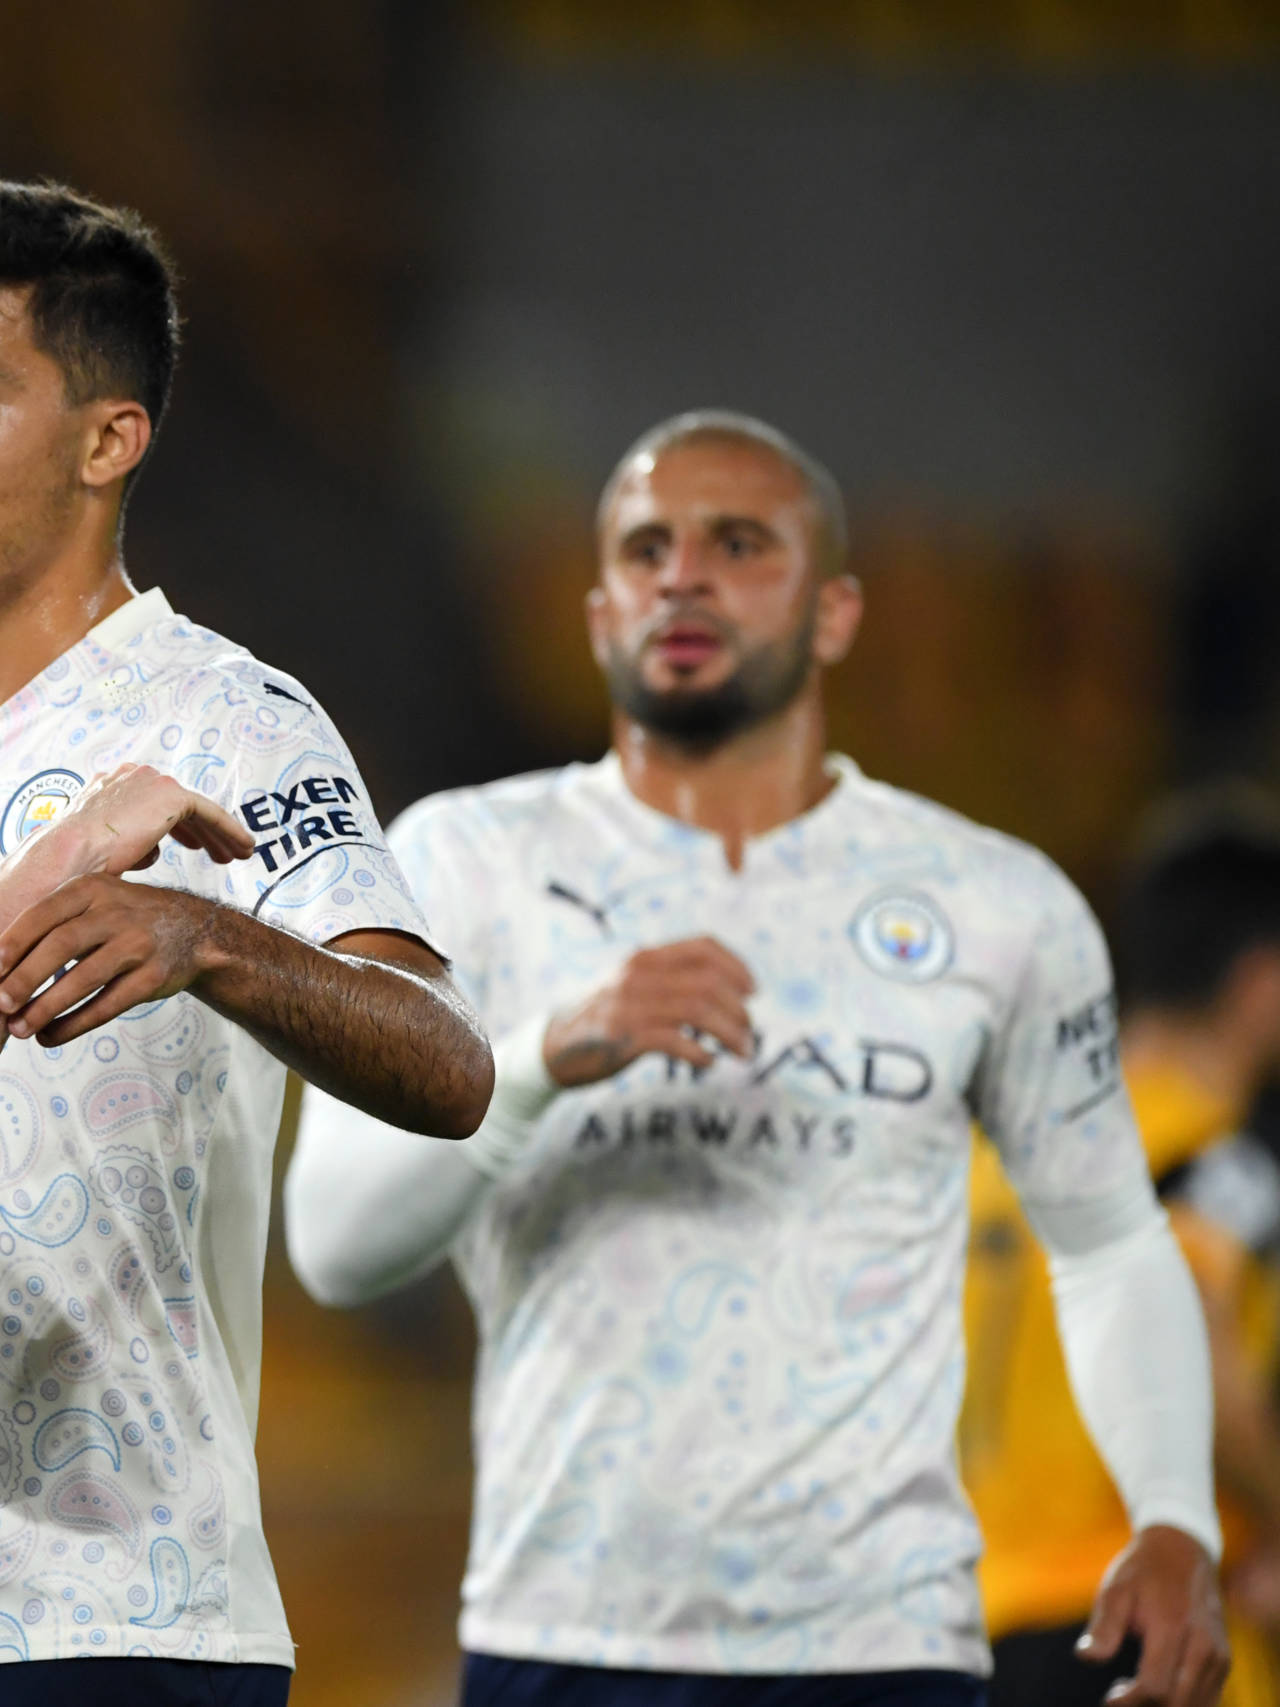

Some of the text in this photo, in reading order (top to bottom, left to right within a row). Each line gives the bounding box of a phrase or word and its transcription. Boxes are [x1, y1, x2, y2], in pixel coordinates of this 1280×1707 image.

[232, 777, 360, 832] EXEN
[252, 810, 363, 873] TIRE
[576, 1107, 858, 1157] AIRWAYS
